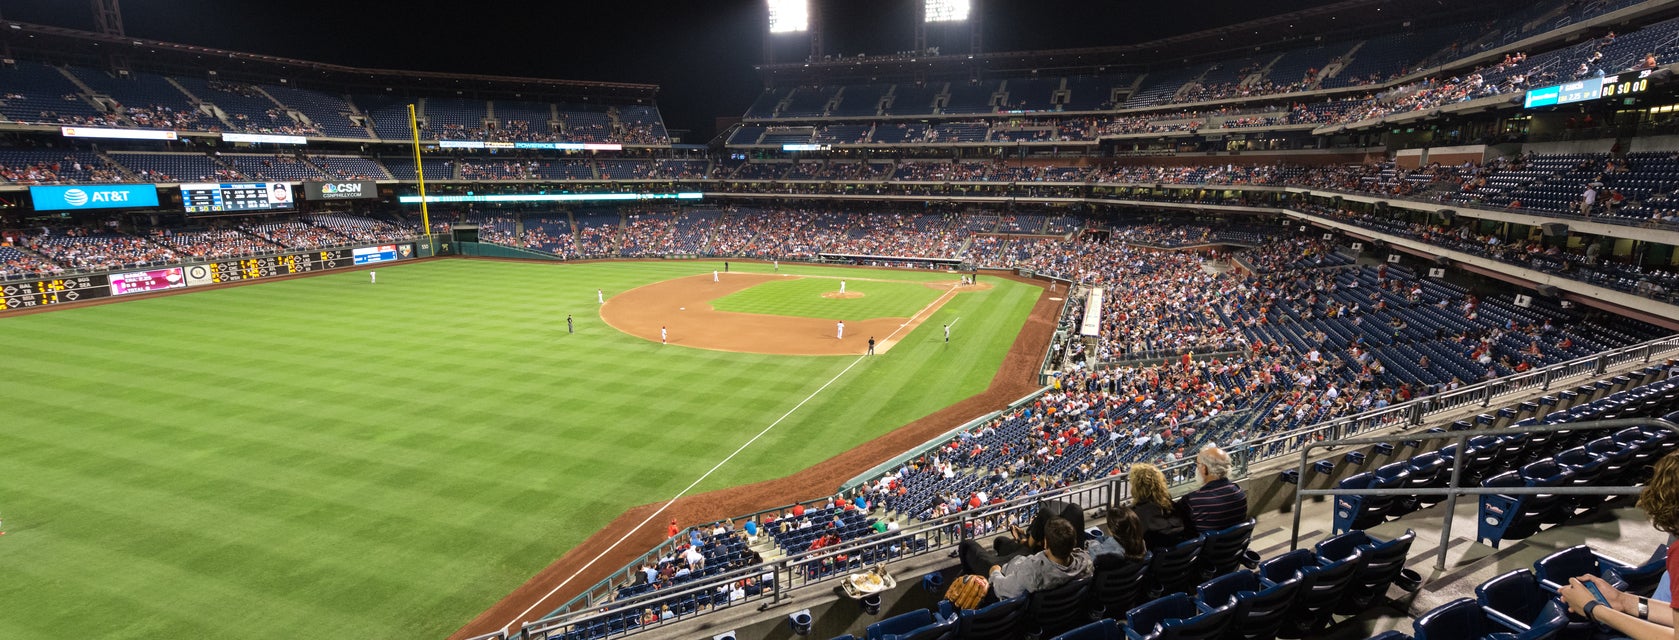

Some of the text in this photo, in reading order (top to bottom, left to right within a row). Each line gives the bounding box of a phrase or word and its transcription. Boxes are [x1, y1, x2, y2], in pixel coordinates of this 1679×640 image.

[1608, 85, 1614, 95] 0
[1617, 84, 1624, 94] S
[1624, 82, 1630, 93] 0
[1640, 79, 1647, 91] 0
[337, 183, 361, 192] CSN
[92, 191, 130, 202] AT&T
